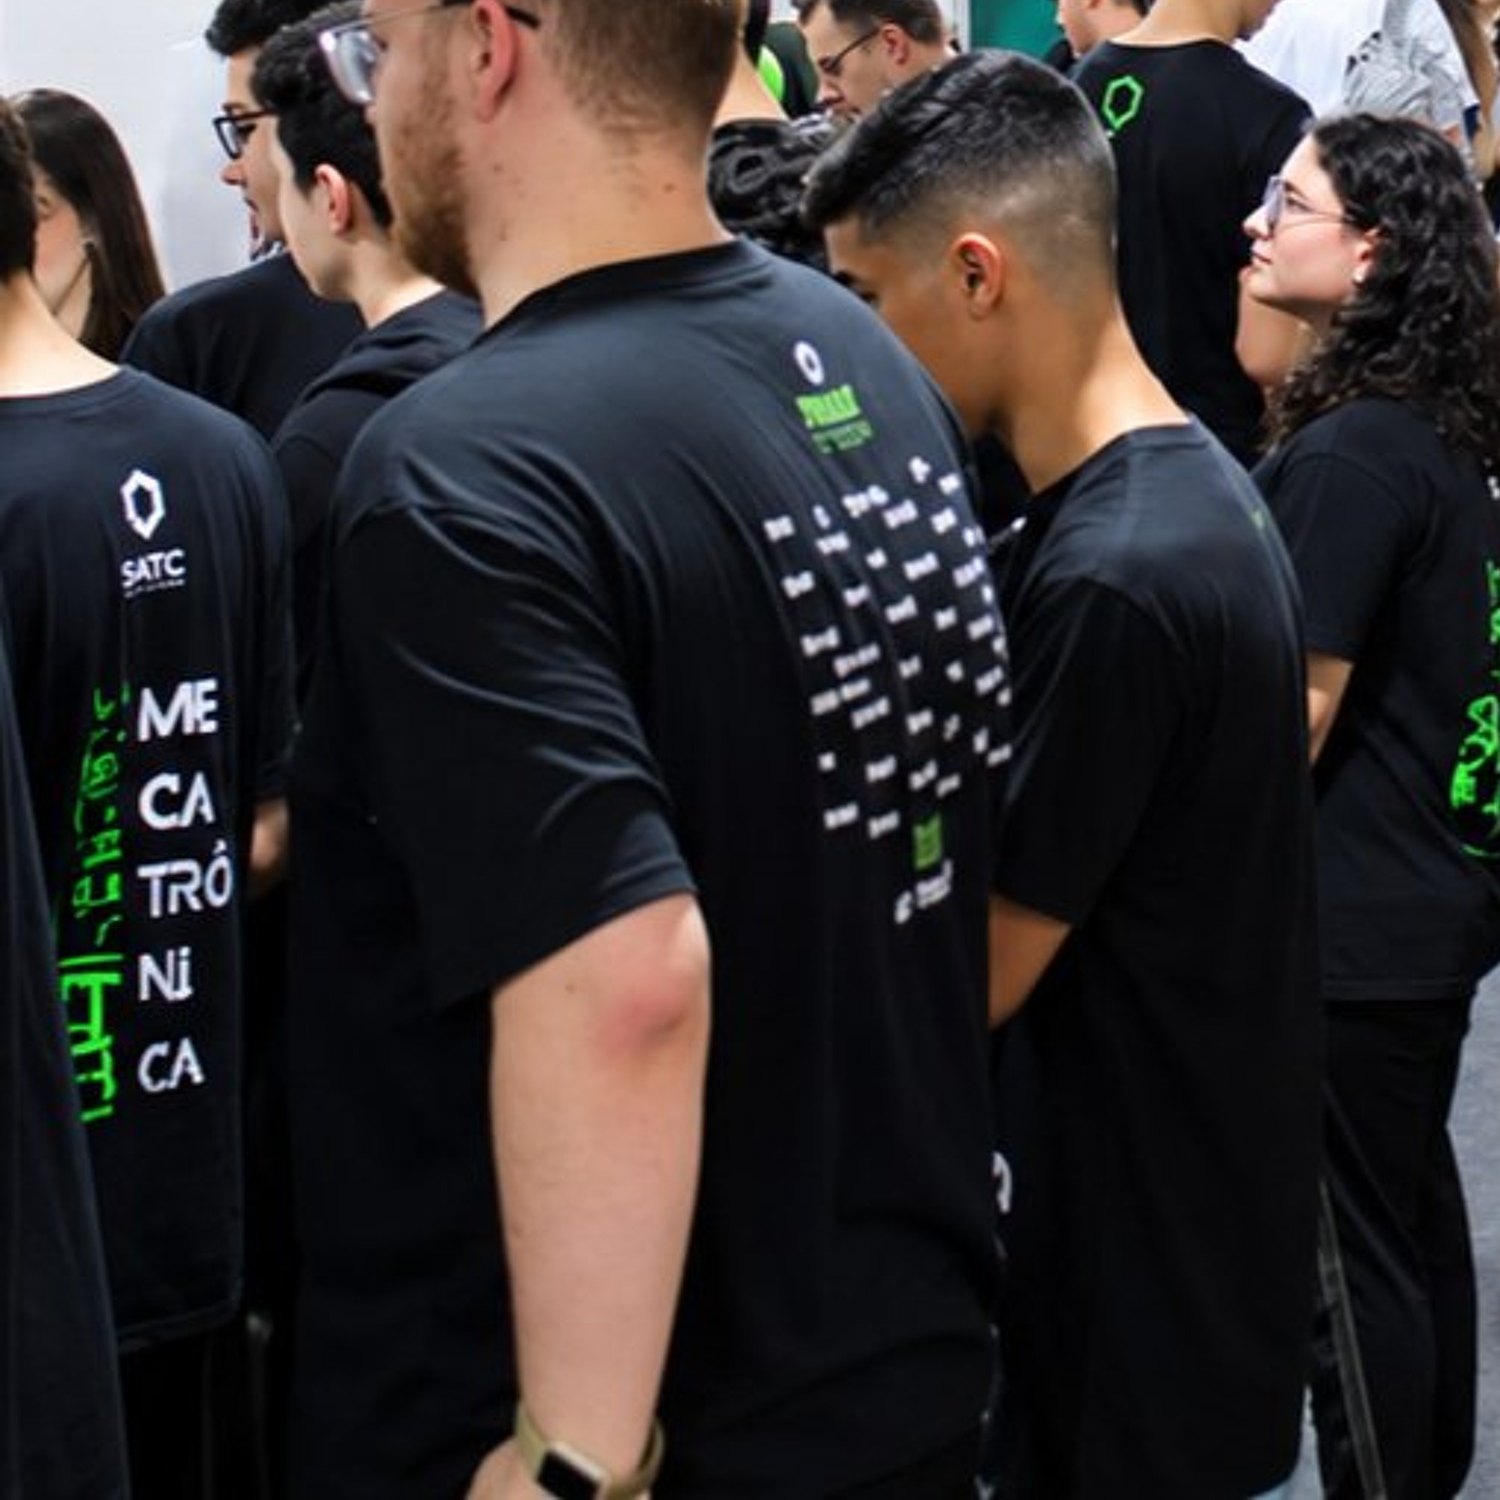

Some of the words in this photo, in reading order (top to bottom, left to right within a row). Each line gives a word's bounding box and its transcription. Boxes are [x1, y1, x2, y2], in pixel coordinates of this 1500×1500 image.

[120, 548, 187, 590] SATC
[137, 678, 219, 743] ME
[138, 770, 216, 830] CA
[138, 1037, 205, 1093] CA
